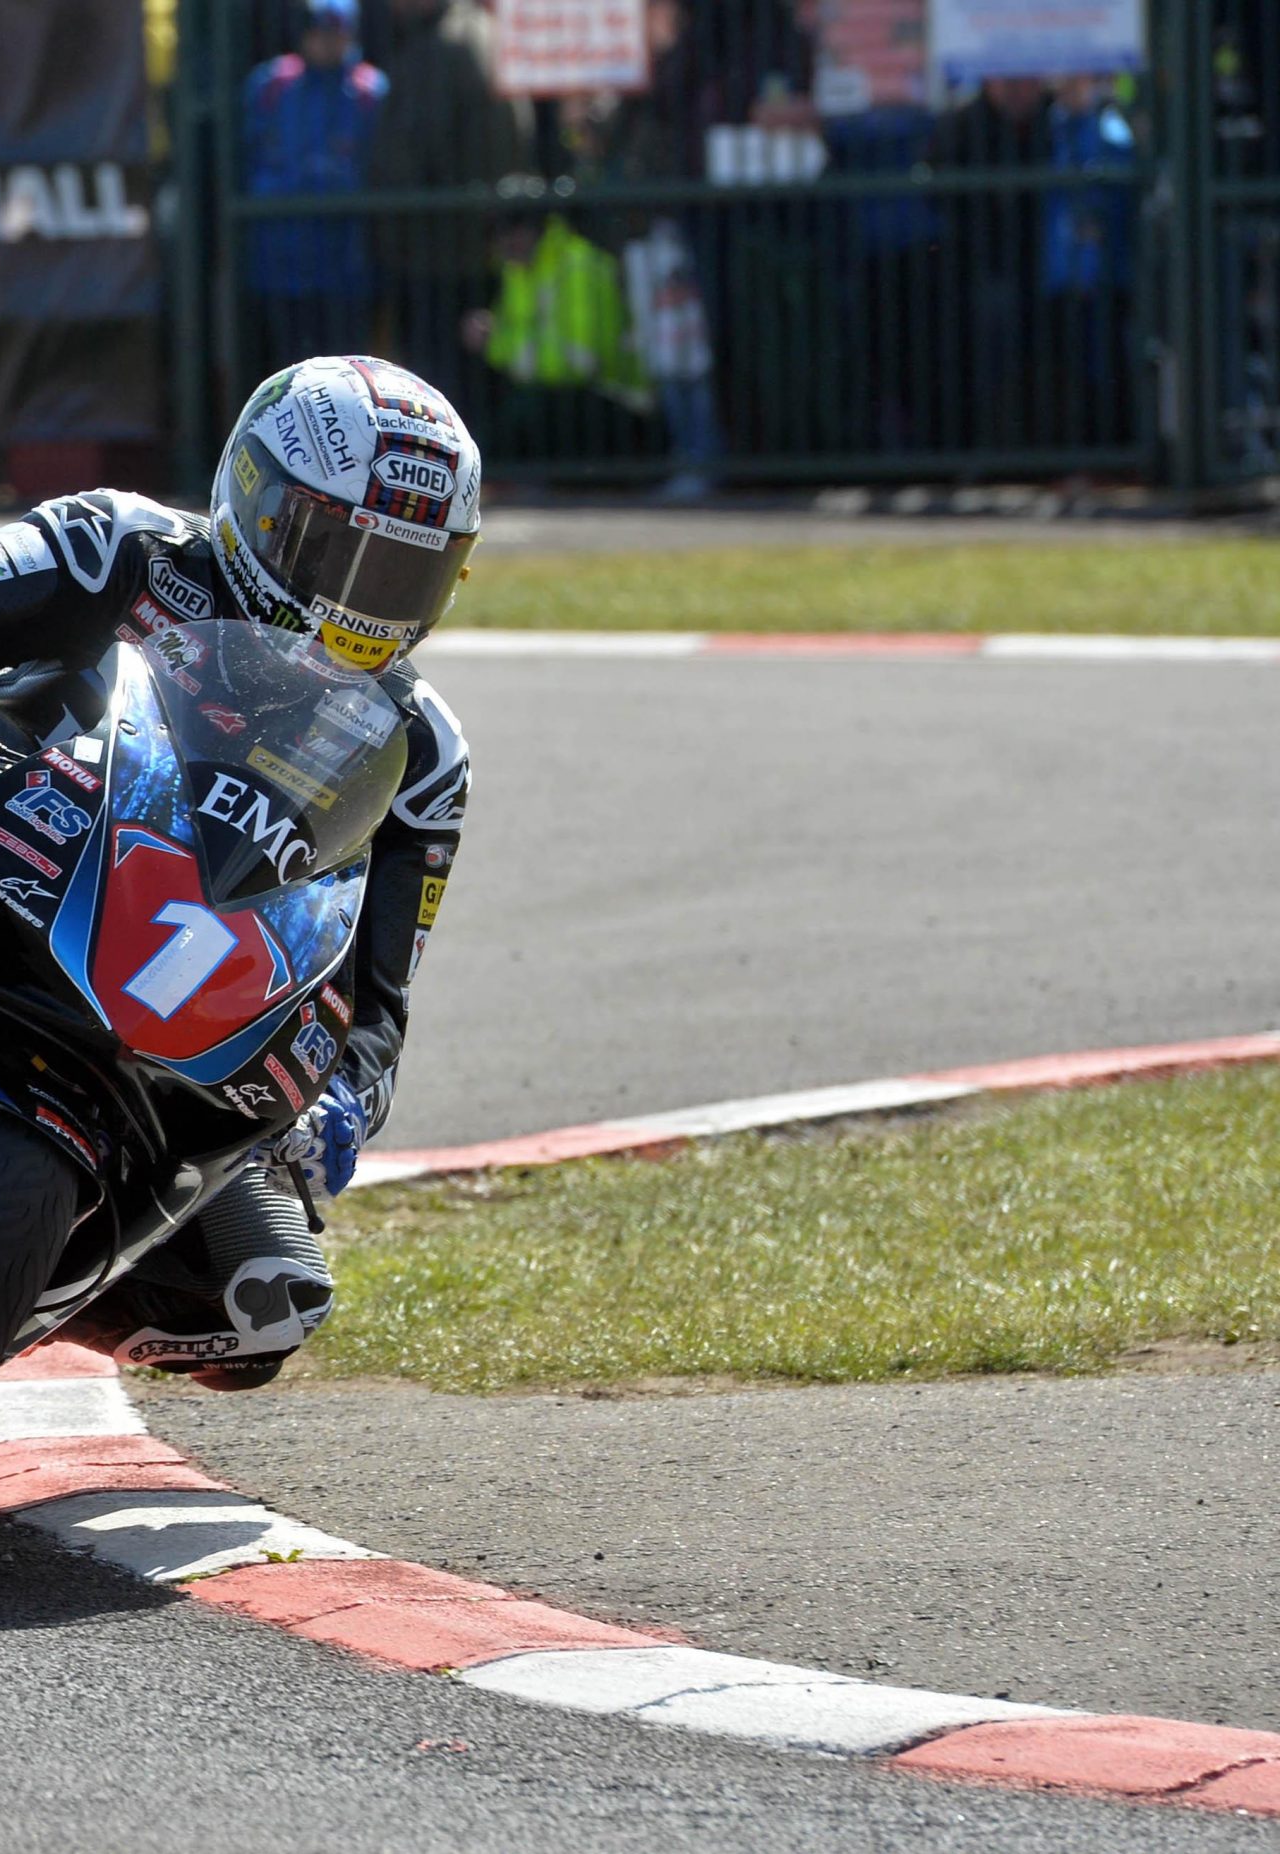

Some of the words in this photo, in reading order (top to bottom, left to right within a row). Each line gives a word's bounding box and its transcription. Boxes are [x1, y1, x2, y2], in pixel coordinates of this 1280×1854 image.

[311, 386, 356, 472] HITACHI
[367, 414, 443, 439] blackhorse
[387, 460, 447, 494] SHOEI
[385, 520, 442, 546] bennetts
[154, 566, 208, 616] SHOEI
[312, 600, 417, 639] DENNISON
[46, 751, 99, 790] MOTUL
[120, 899, 240, 1021] 1
[322, 986, 350, 1024] MOTUL
